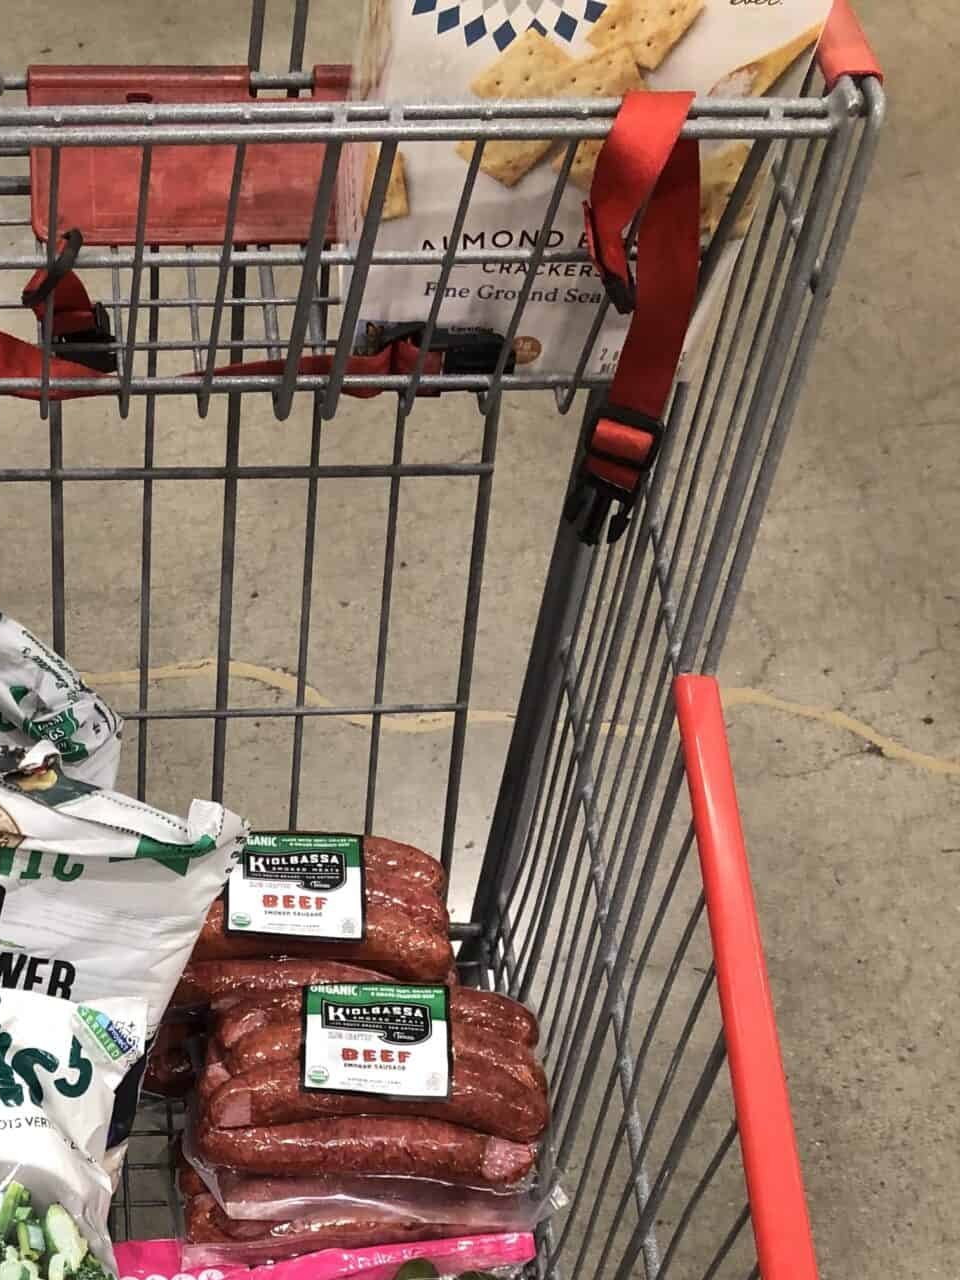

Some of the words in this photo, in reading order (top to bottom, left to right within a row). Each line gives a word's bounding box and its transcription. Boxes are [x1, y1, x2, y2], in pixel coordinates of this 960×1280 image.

[424, 281, 471, 300] Fne
[477, 285, 558, 304] Grond
[249, 854, 340, 873] KIOLBASSA
[262, 894, 328, 910] BEEF
[310, 983, 358, 997] ORGANIC
[328, 1005, 424, 1021] KIOLBASSA
[341, 1048, 411, 1063] BEEF
